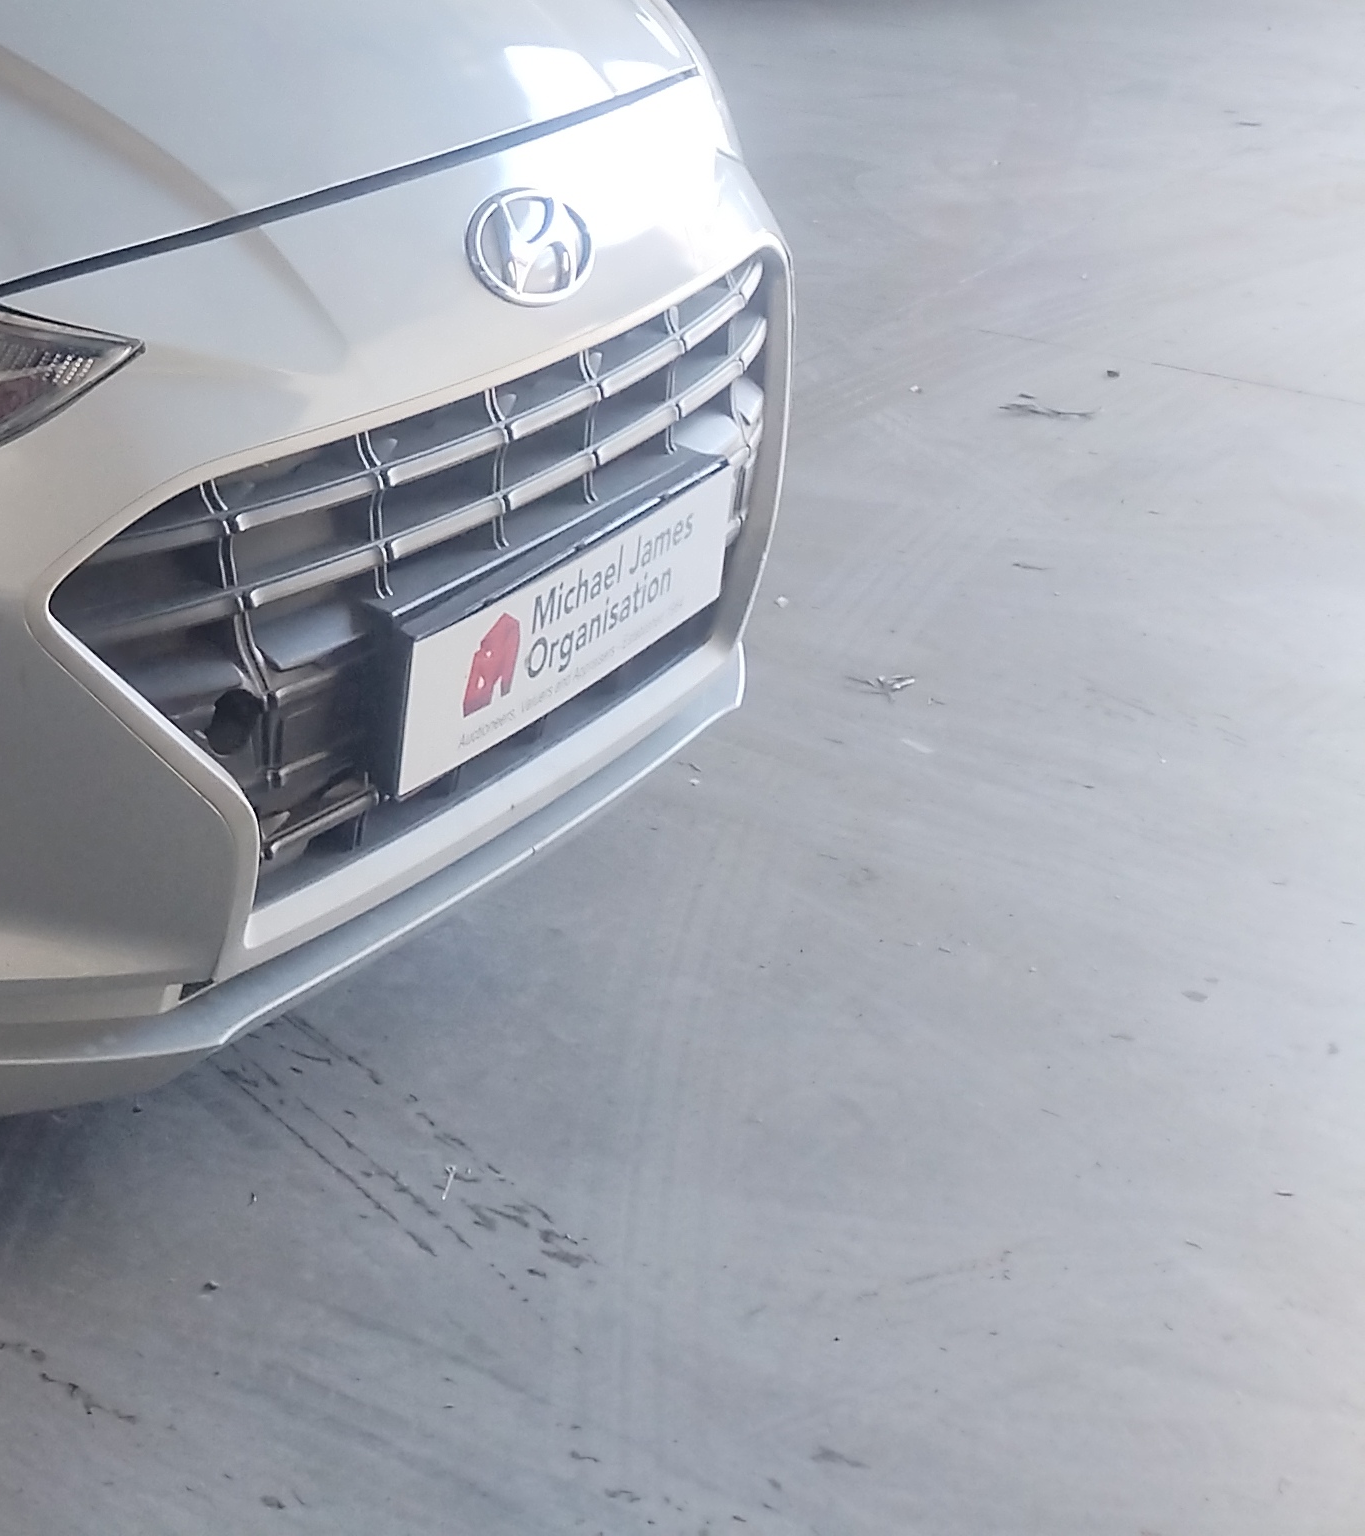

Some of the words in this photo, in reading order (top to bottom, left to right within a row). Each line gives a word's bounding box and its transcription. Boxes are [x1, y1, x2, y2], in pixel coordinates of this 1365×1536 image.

[525, 567, 672, 679] Organisation
[531, 544, 624, 634] Michael
[629, 513, 694, 575] James
